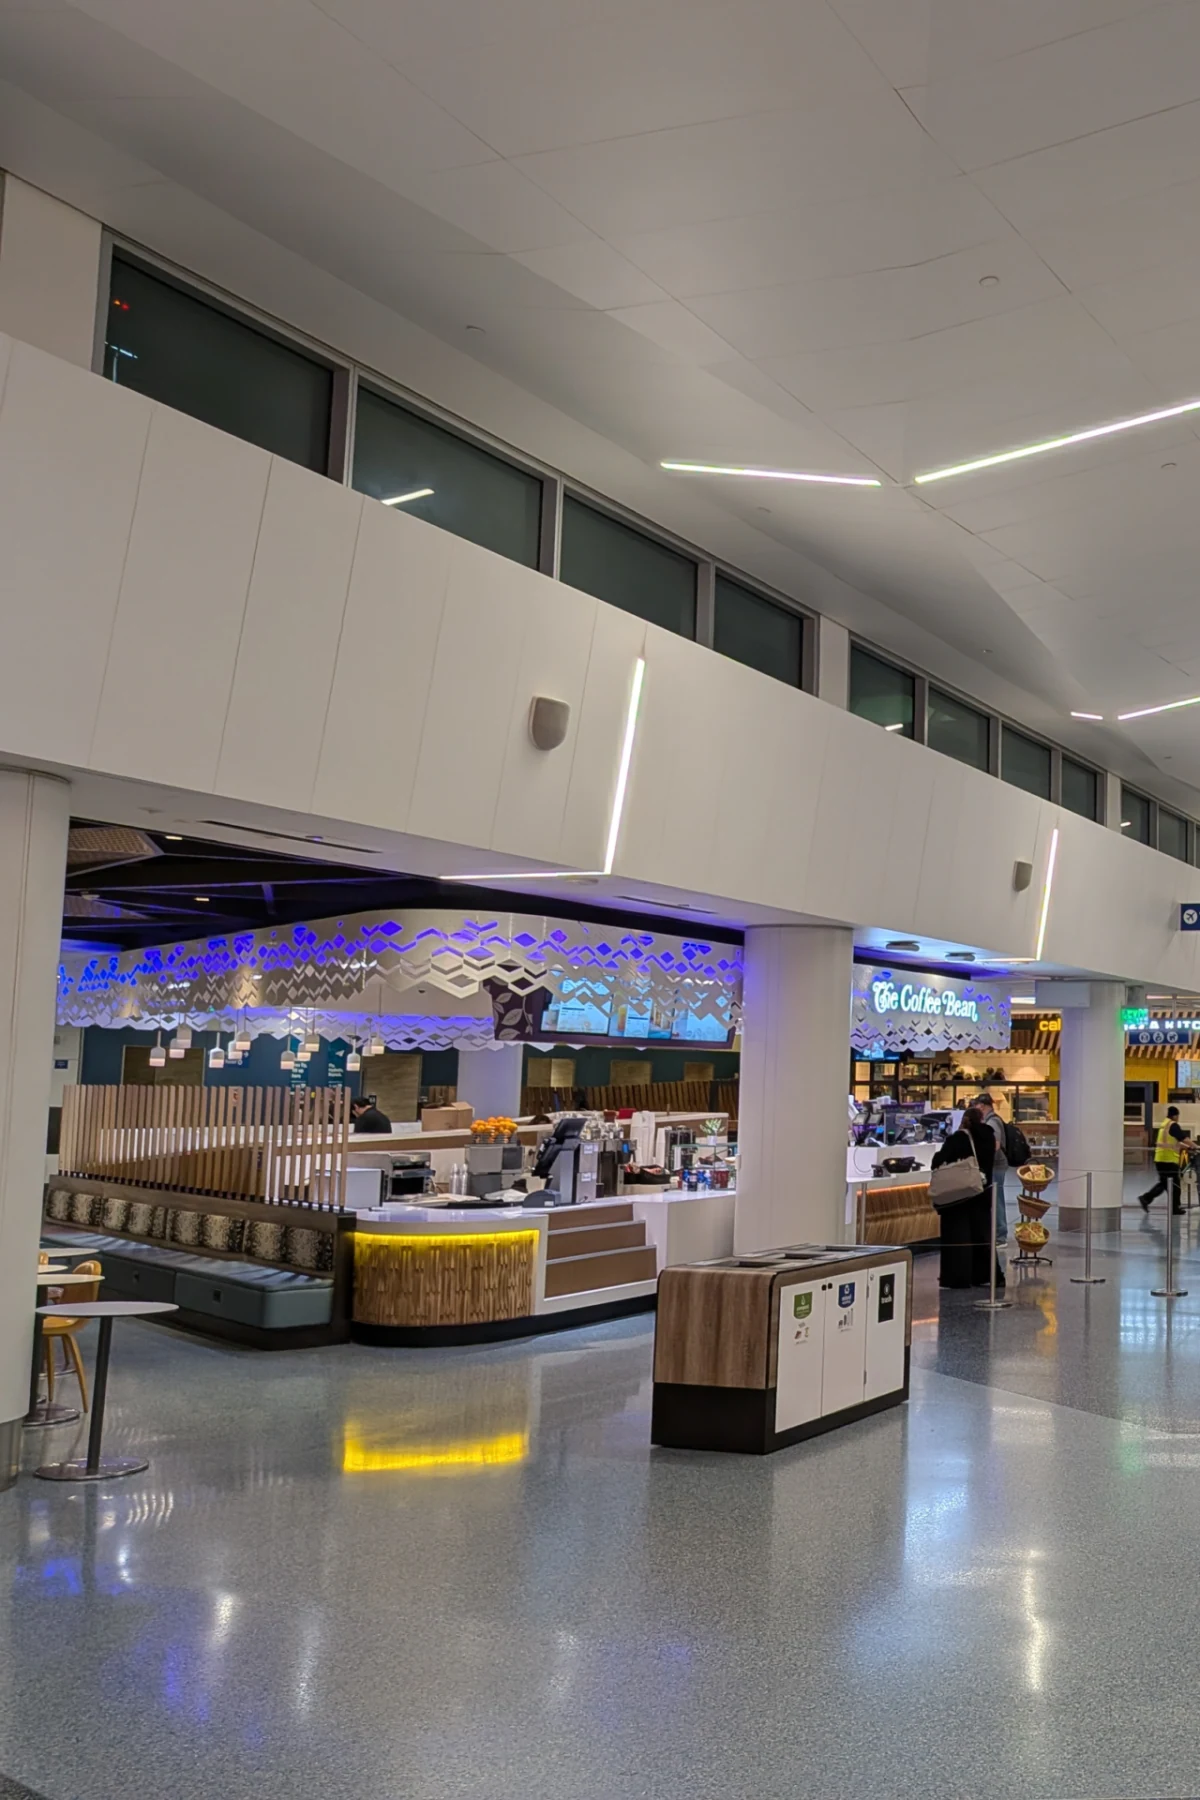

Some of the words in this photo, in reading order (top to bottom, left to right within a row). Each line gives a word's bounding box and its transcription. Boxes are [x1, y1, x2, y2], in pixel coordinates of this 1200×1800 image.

[872, 981, 899, 1013] The
[901, 984, 941, 1015] Coffee
[942, 990, 978, 1022] Bean
